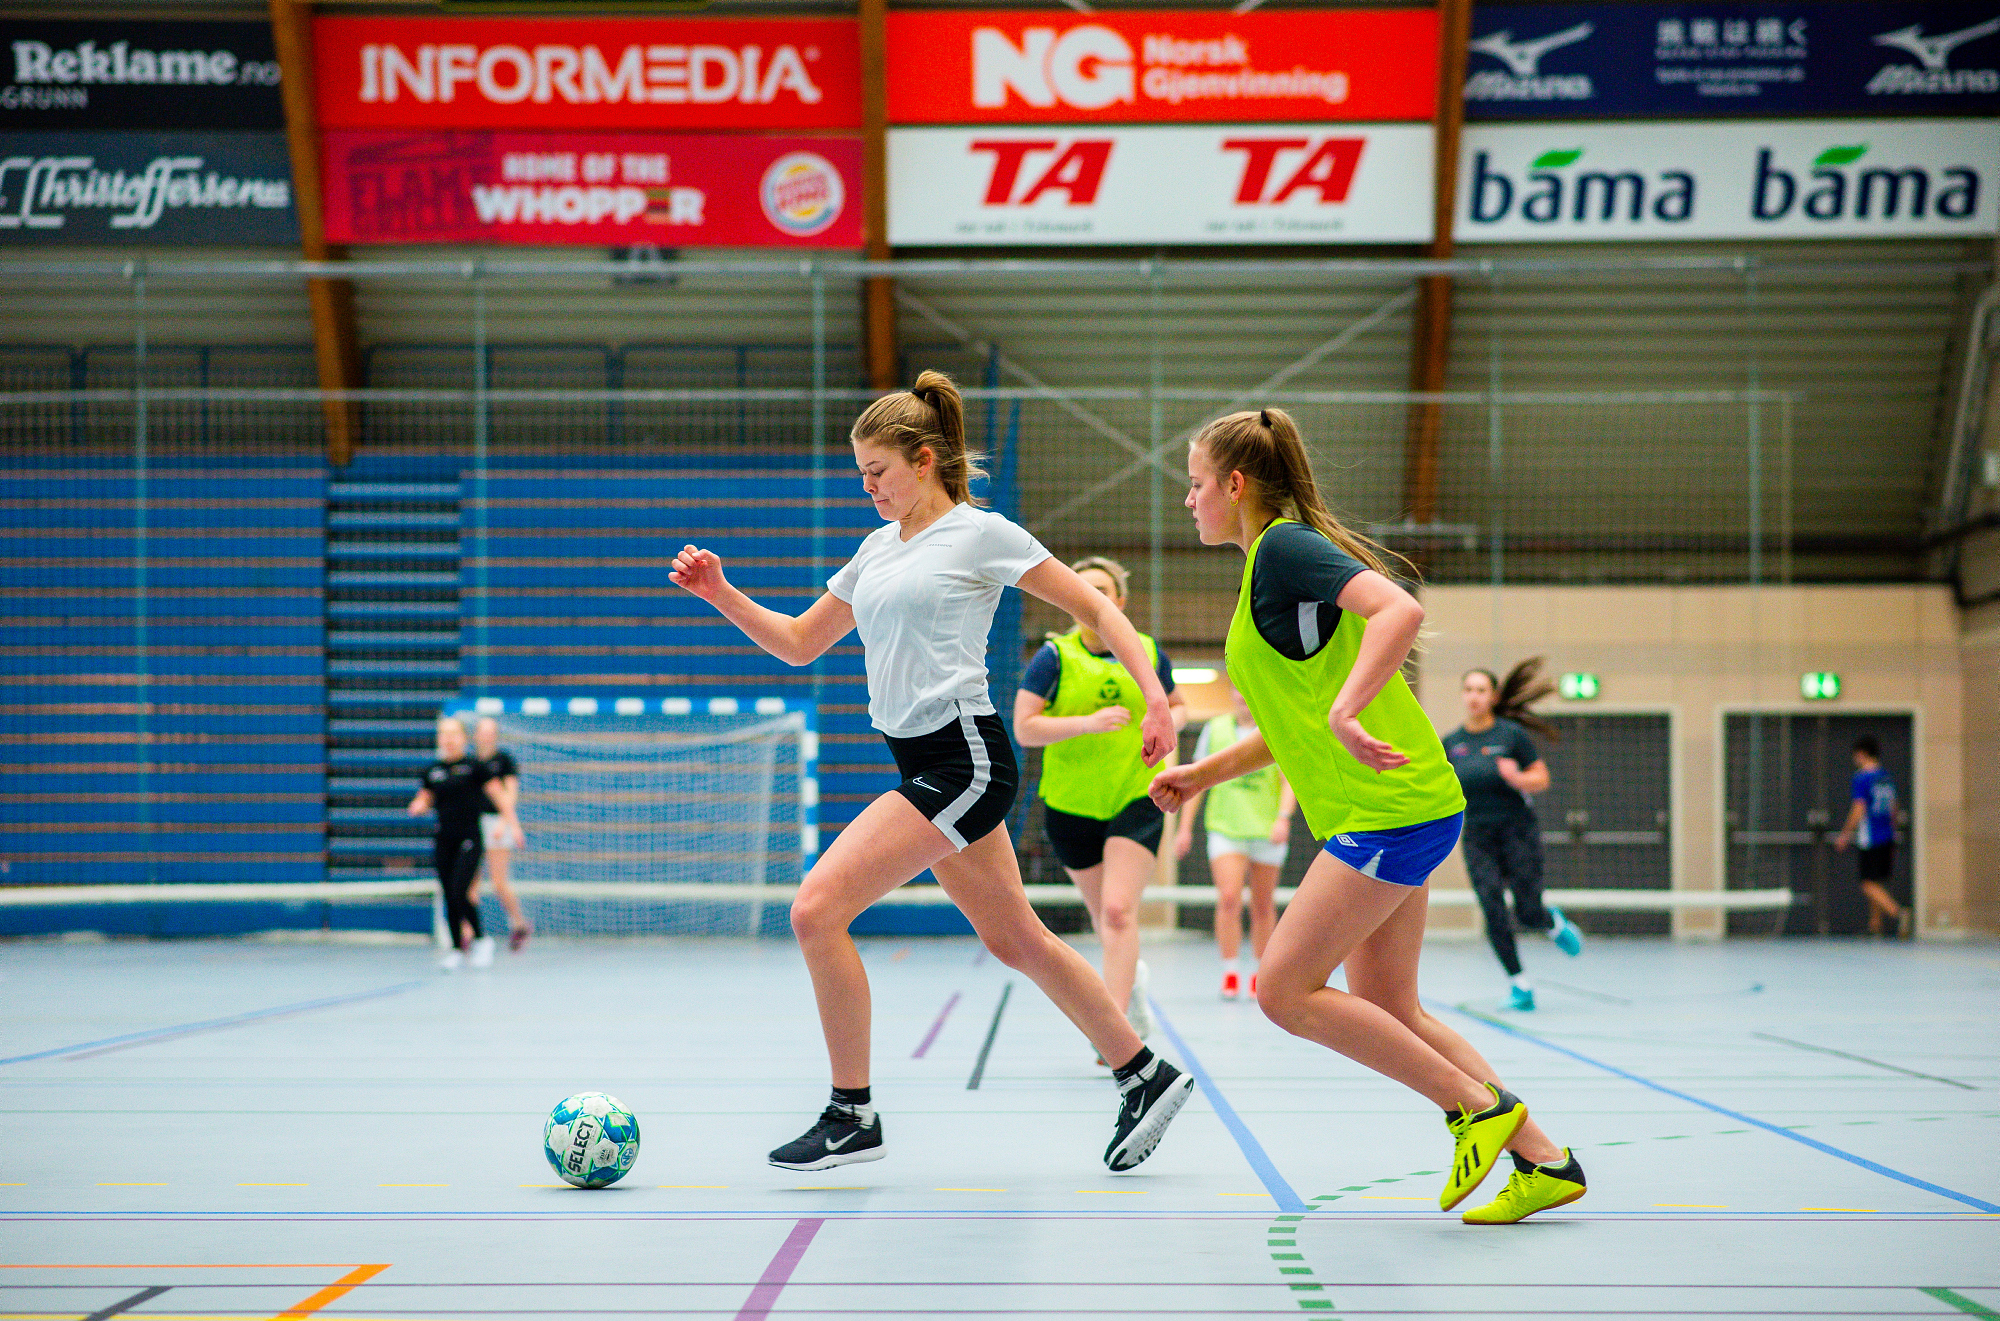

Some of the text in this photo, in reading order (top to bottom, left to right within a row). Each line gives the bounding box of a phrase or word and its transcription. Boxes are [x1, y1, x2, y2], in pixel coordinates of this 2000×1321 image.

[12, 40, 282, 86] Reklame.no
[972, 26, 1136, 110] NG
[1144, 33, 1249, 65] Norsk
[0, 86, 89, 110] GRUNN
[358, 44, 823, 104] INFORMEDIA
[1143, 65, 1349, 104] Gjenvinning
[502, 152, 670, 183] HOME OF THE
[969, 137, 1116, 206] TA
[1221, 136, 1368, 205] TA
[567, 1120, 594, 1173] SELECT
